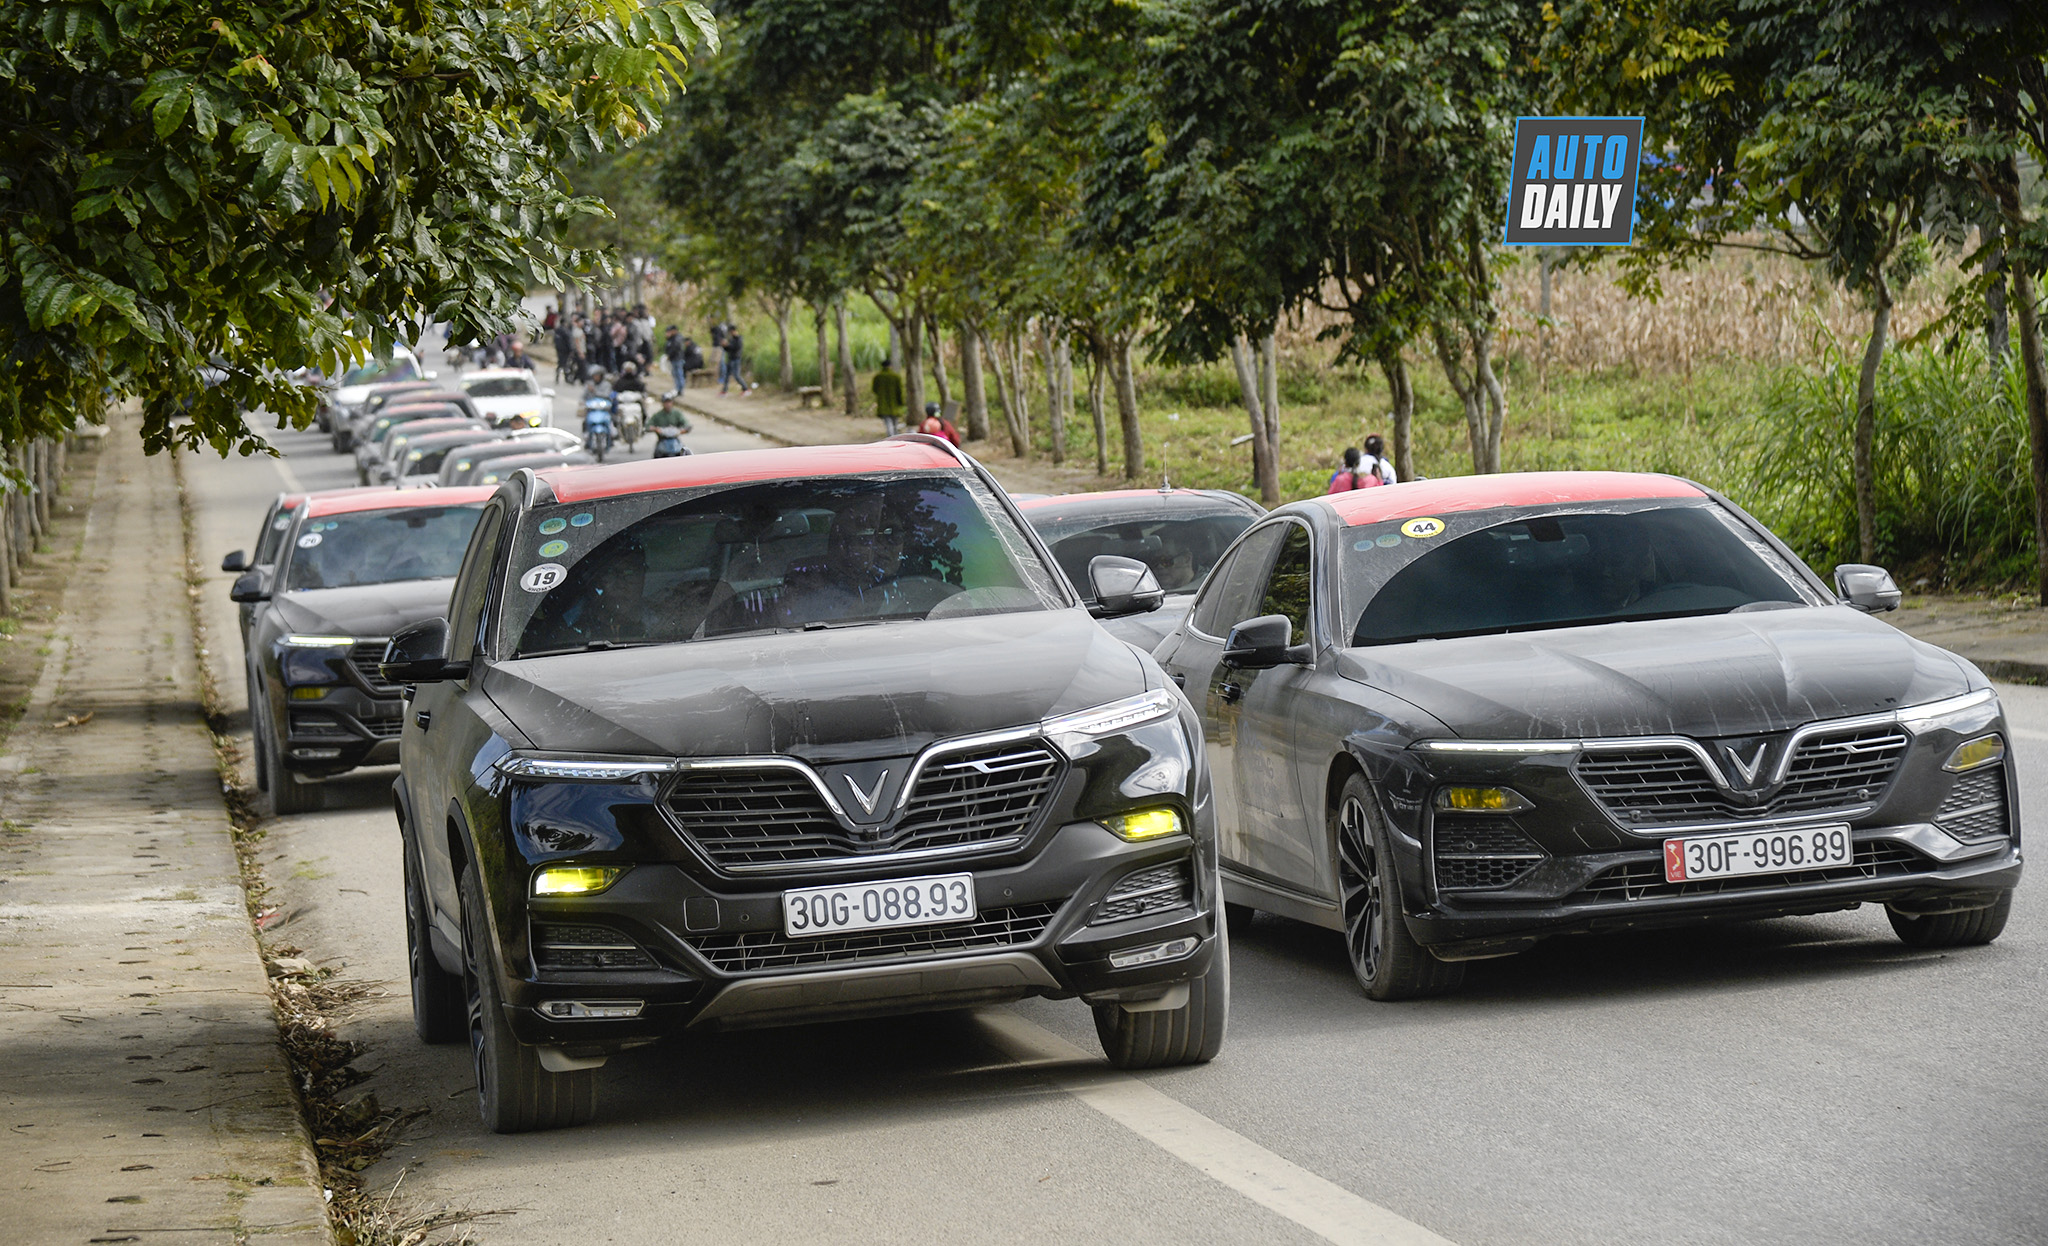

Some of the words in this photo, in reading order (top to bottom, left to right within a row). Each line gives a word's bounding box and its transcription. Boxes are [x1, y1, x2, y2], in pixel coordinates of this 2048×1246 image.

[1413, 522, 1437, 533] 44
[533, 571, 557, 587] 19
[1689, 831, 1846, 874] 30F-996.89
[790, 881, 968, 930] 30G-088.93
